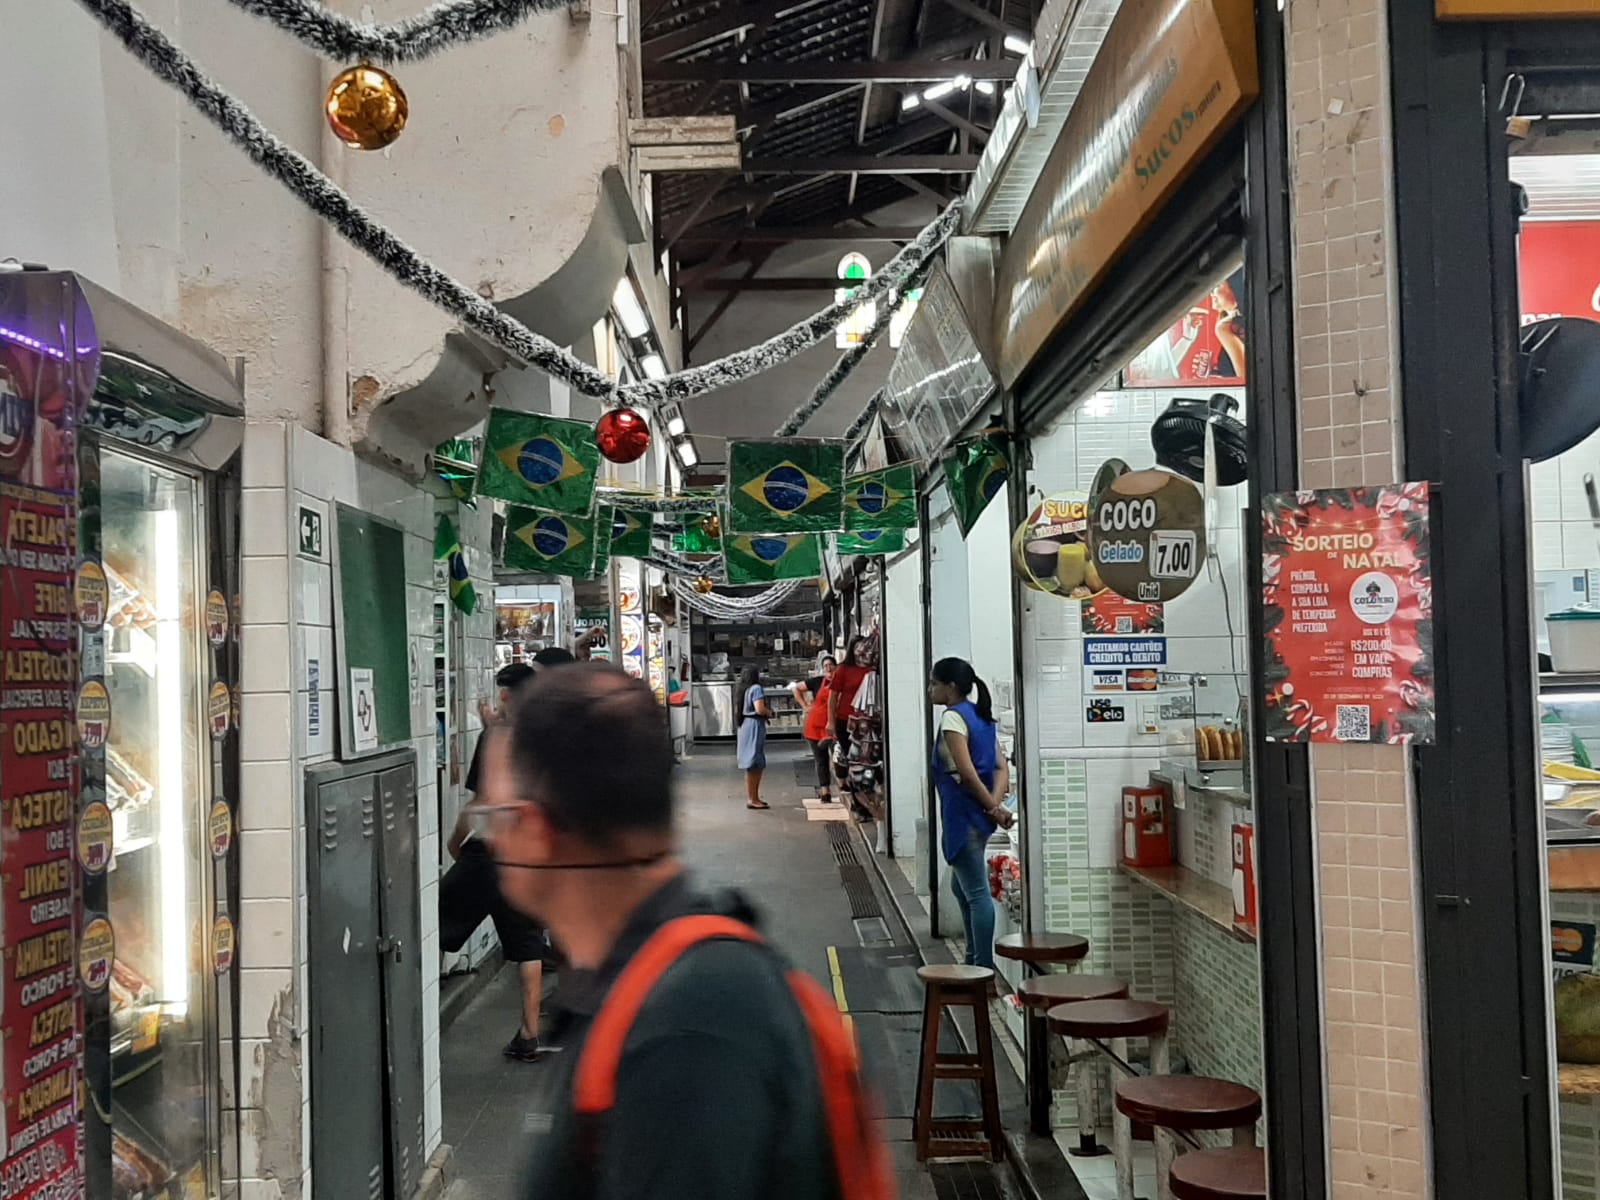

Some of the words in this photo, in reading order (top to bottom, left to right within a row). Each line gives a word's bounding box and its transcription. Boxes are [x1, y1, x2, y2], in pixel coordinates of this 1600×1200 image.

[1100, 498, 1157, 531] COCO
[1099, 541, 1143, 562] Gelado
[1292, 533, 1374, 552] SORTEIO
[1158, 542, 1191, 574] 7.00
[1343, 551, 1402, 569] NATAL
[1098, 675, 1119, 685] VISA
[1103, 709, 1123, 720] elo
